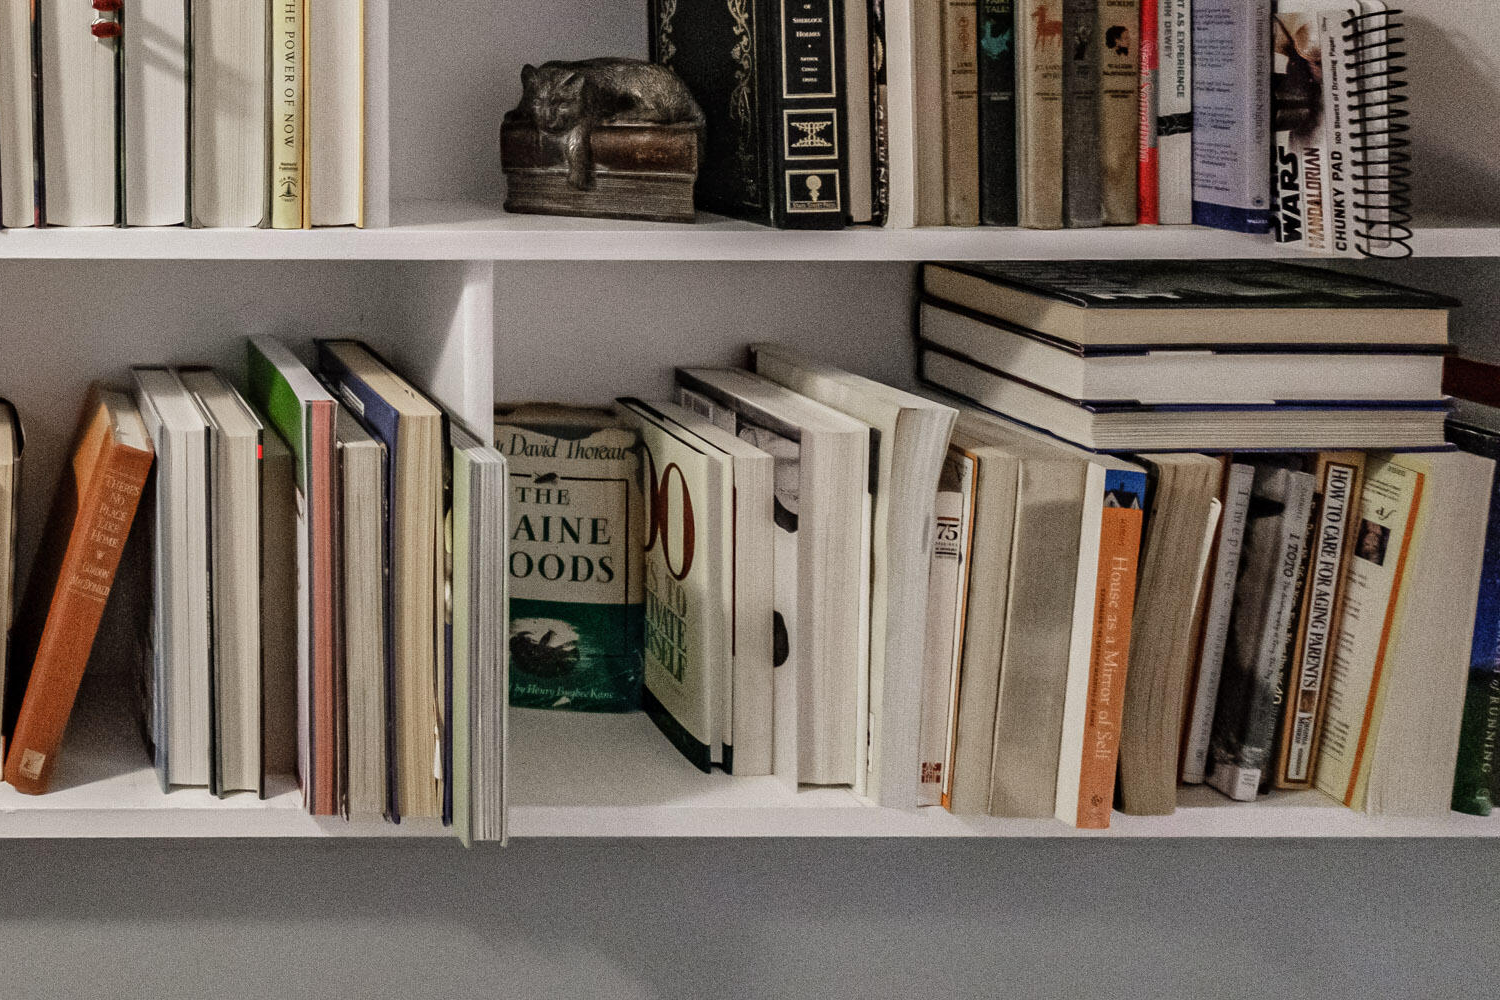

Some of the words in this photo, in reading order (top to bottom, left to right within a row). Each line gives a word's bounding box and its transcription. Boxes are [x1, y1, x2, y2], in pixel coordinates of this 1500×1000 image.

[1177, 12, 1184, 27] AS
[1164, 21, 1172, 58] DEWEY
[284, 31, 296, 82] POWER
[1330, 60, 1338, 90] Drawing
[284, 89, 296, 106] OF
[284, 114, 296, 148] NOW
[1331, 151, 1343, 181] PAD
[1278, 146, 1302, 242] WARS
[1304, 148, 1325, 249] MANDALORIAN
[1333, 187, 1347, 251] CHUNKY
[511, 433, 557, 458] David
[566, 437, 627, 461] Thoreau
[516, 487, 569, 506] THE
[1328, 468, 1349, 502] HOW
[1326, 504, 1343, 522] TO
[512, 514, 611, 546] AINE
[935, 523, 959, 540] 75
[1321, 525, 1340, 558] CARE
[510, 552, 614, 583] OODS
[1283, 544, 1298, 577] TOTO
[1317, 562, 1335, 587] FOR
[1108, 556, 1128, 607] House
[1107, 614, 1119, 630] as
[1311, 589, 1331, 630] AGING
[1106, 636, 1116, 644] a
[1302, 632, 1324, 688] PARENTS
[1100, 650, 1120, 706] Mirror
[1097, 711, 1113, 726] of
[1095, 731, 1113, 760] Self
